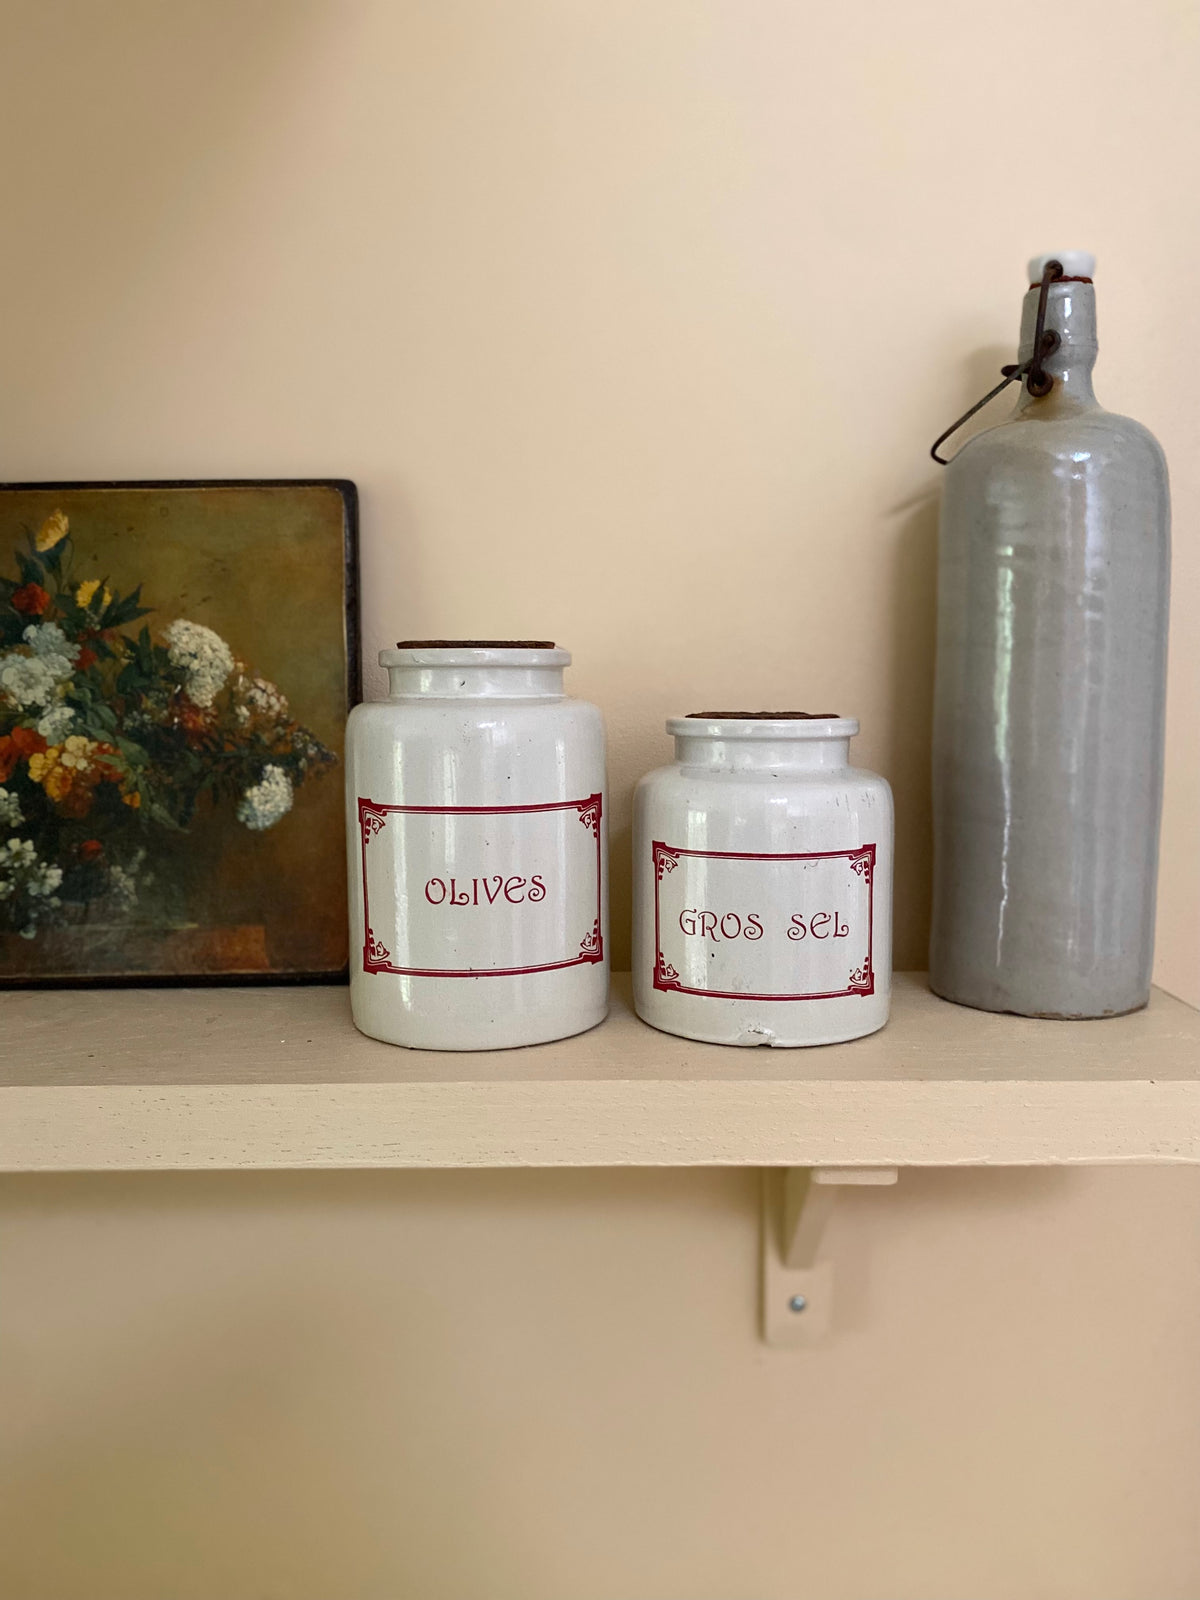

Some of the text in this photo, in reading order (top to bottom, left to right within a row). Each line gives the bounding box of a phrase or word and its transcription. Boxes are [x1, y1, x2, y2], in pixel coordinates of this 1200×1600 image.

[424, 874, 547, 906] OLIVES
[679, 908, 849, 942] GROS SEL
